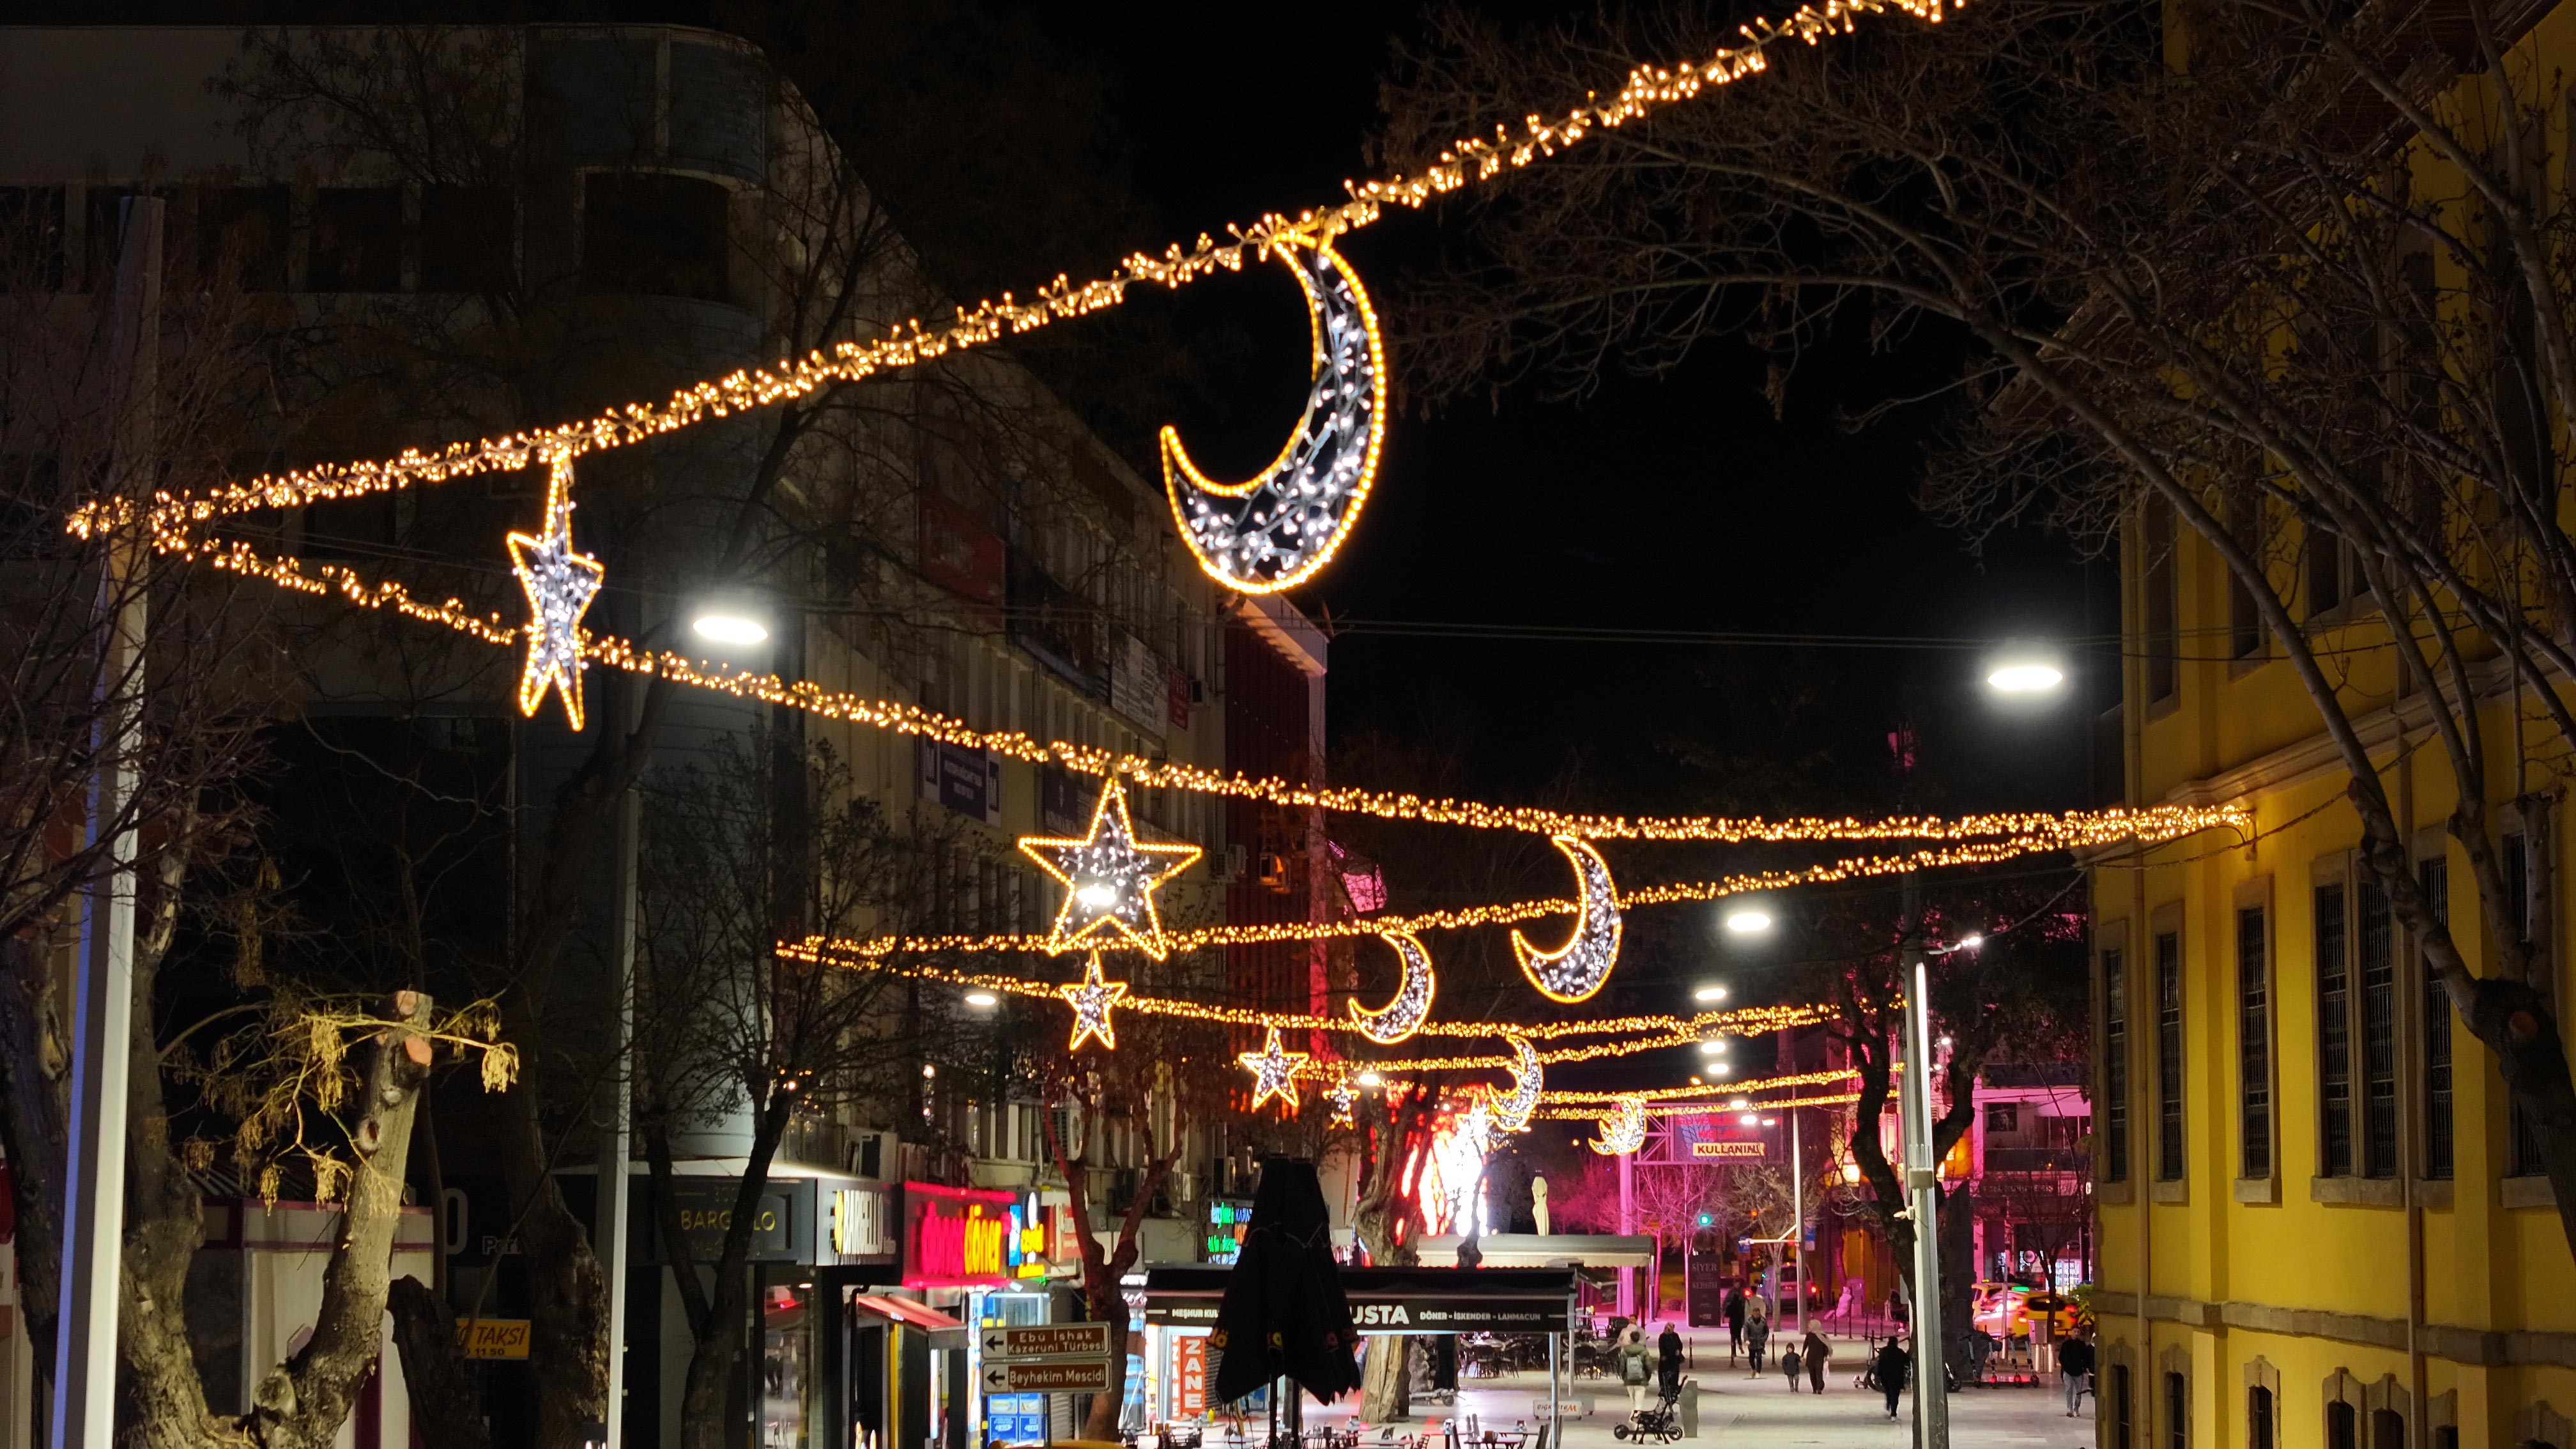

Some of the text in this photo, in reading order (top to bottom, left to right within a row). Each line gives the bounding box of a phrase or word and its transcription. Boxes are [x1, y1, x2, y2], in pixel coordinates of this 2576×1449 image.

[680, 1209, 776, 1232] BARGLO
[1420, 1310, 1447, 1321] DÖNER
[1498, 1313, 1540, 1321] LAHMACUN
[477, 1324, 528, 1346] TAKSİ
[1009, 1368, 1105, 1386] Beyhekim Mescidi
